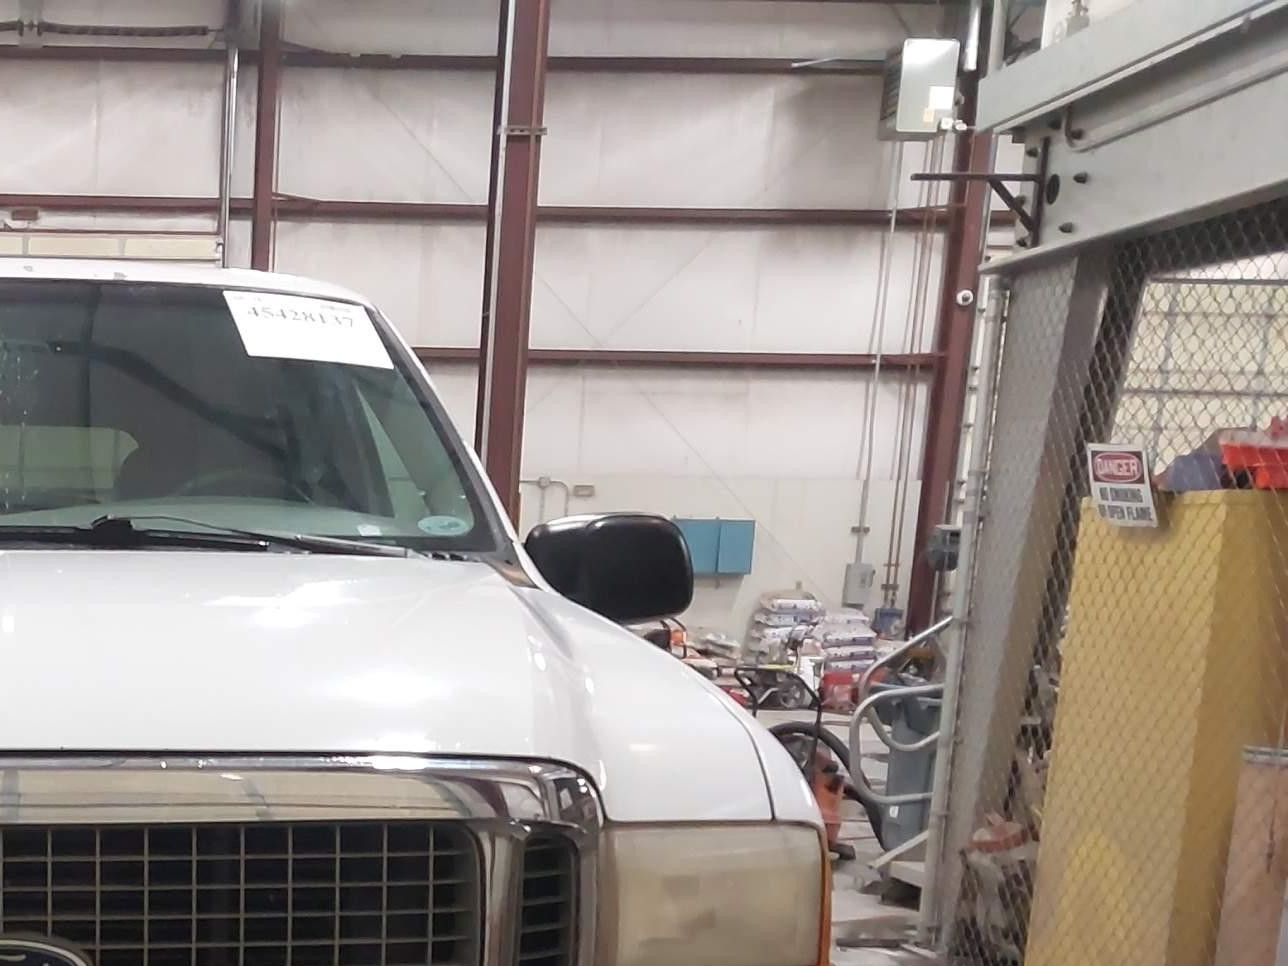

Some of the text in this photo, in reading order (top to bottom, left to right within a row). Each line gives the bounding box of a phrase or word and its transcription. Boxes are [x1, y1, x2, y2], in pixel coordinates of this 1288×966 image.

[248, 306, 354, 328] 45428137
[1096, 458, 1138, 476] DANGER
[1126, 506, 1154, 521] FLAME
